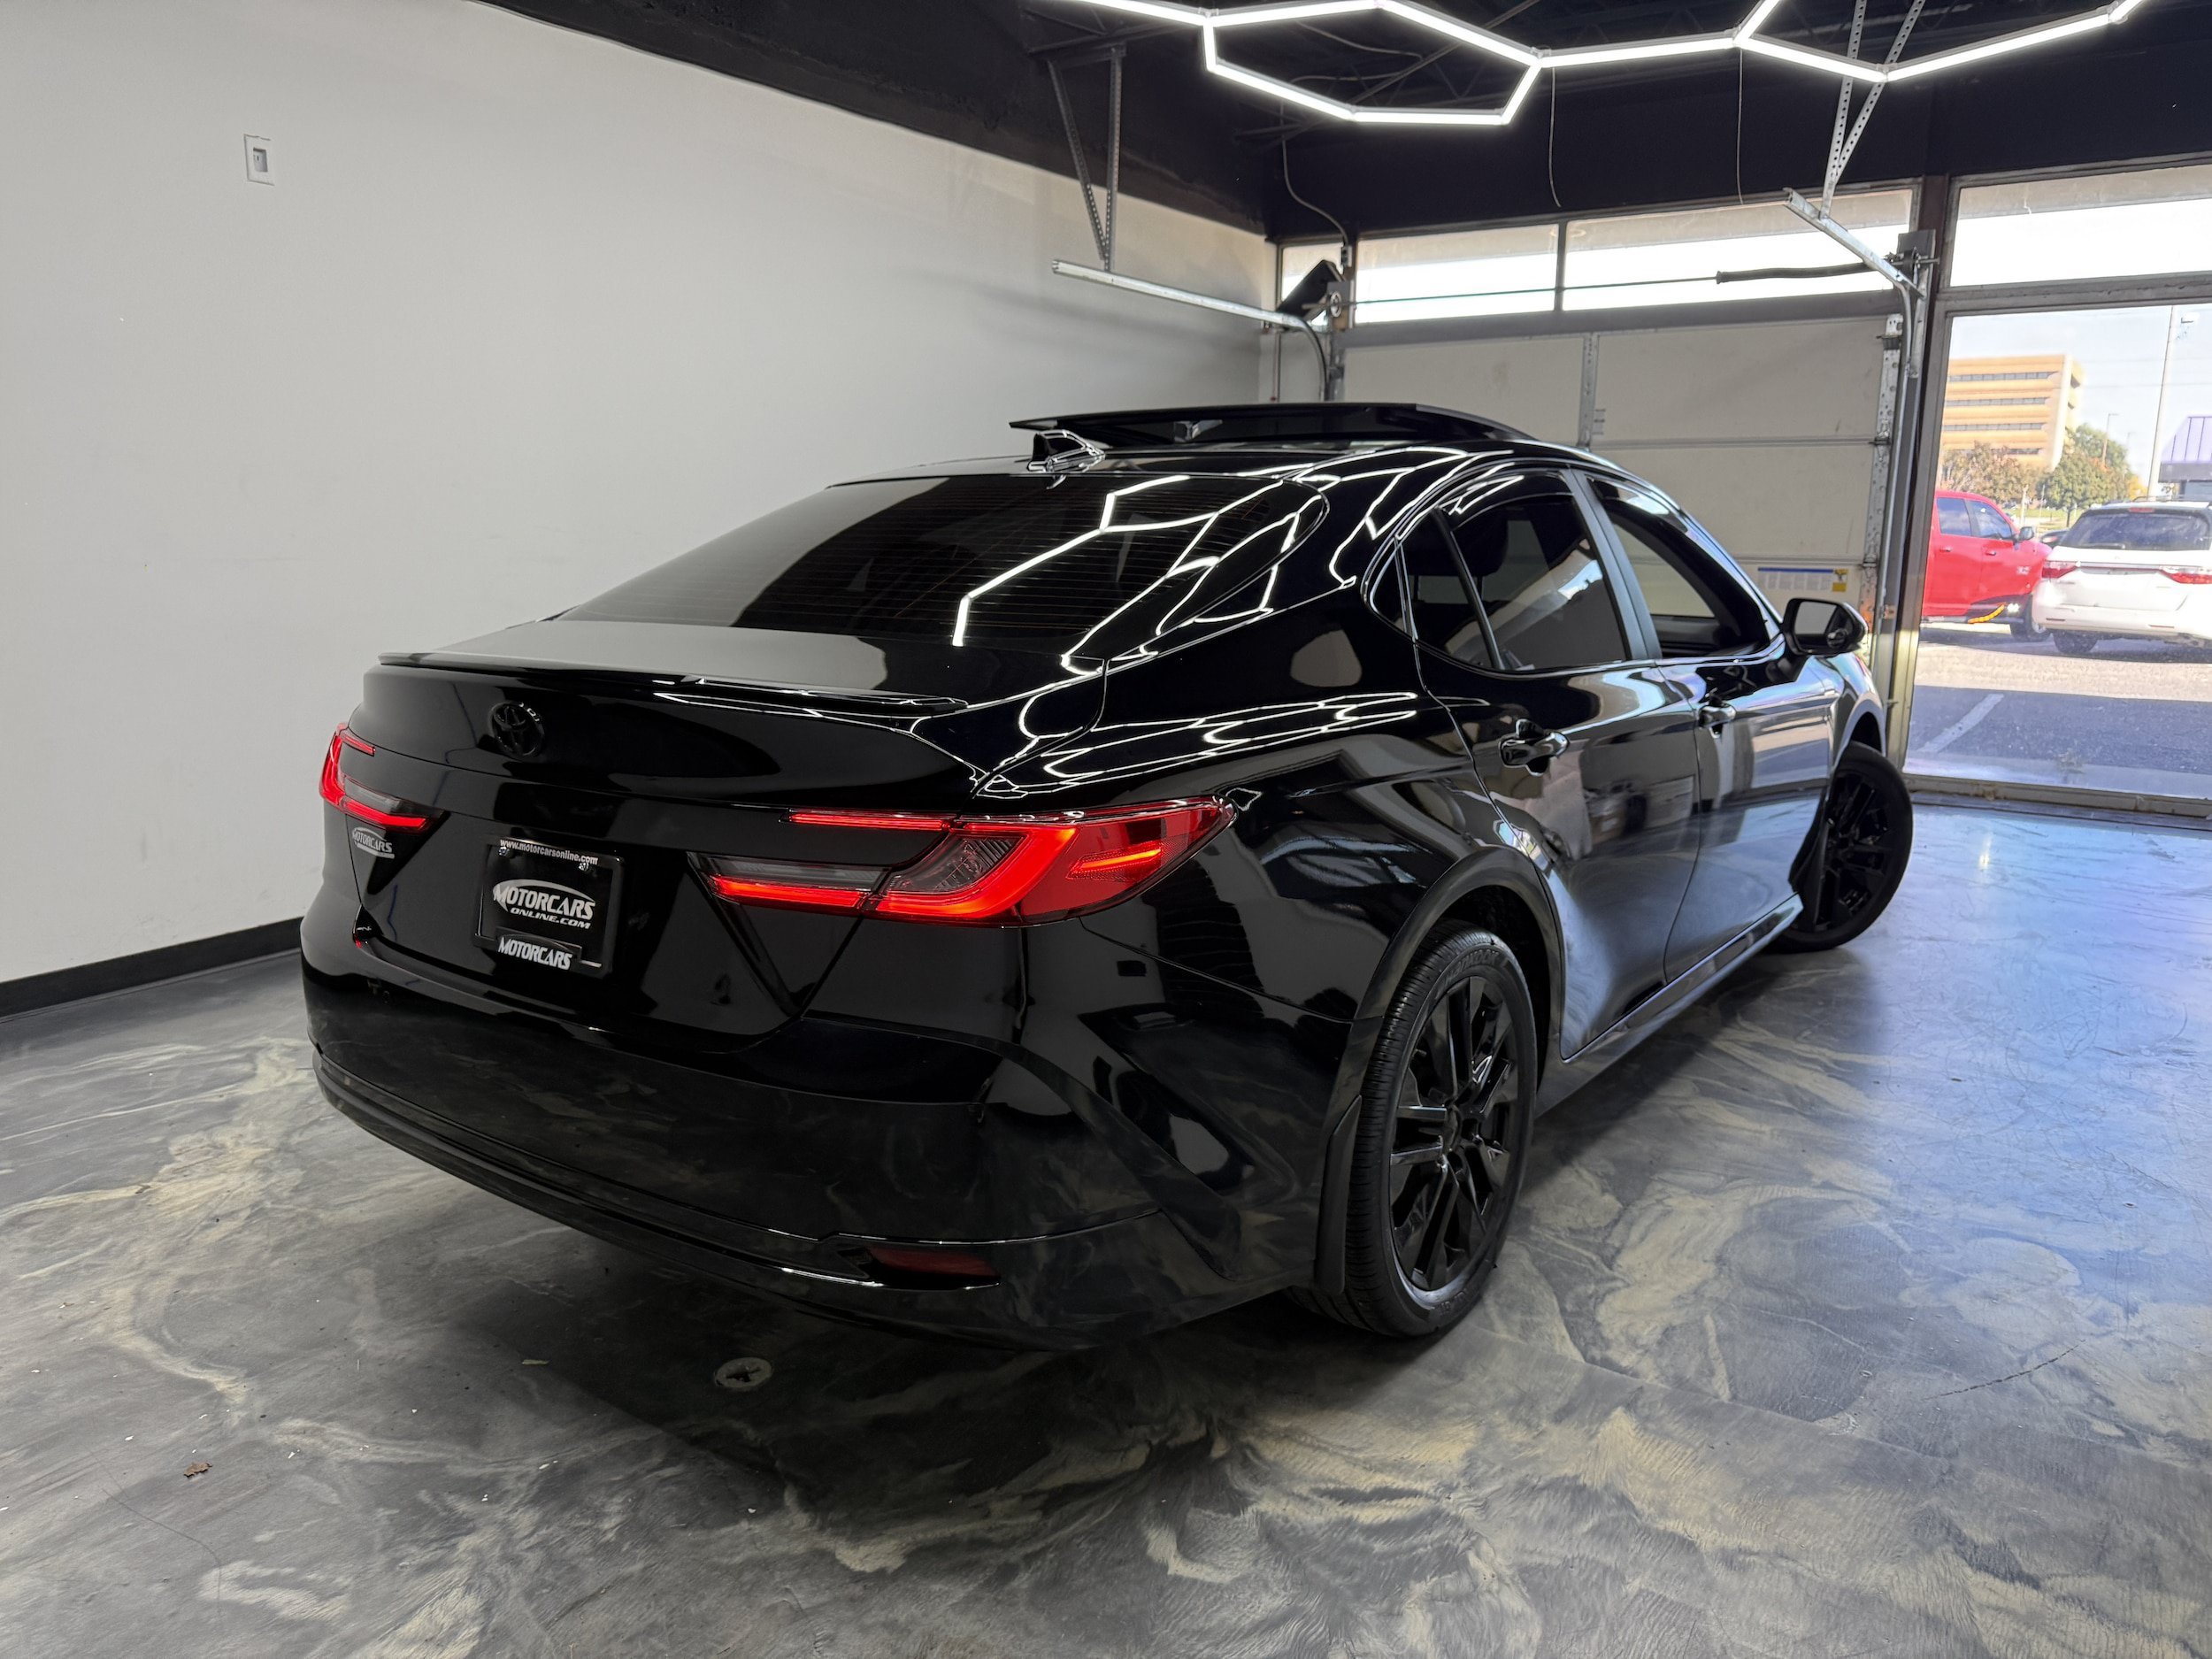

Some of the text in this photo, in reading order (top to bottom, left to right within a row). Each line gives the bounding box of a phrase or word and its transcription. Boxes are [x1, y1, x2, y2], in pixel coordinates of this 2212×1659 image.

[352, 831, 393, 853] MOTORCARS
[499, 839, 599, 865] www.motorcarsonline.com
[493, 884, 596, 920] MOTORCARS
[510, 907, 592, 930] ONLINE.COM
[497, 936, 573, 971] MOTORCARS
